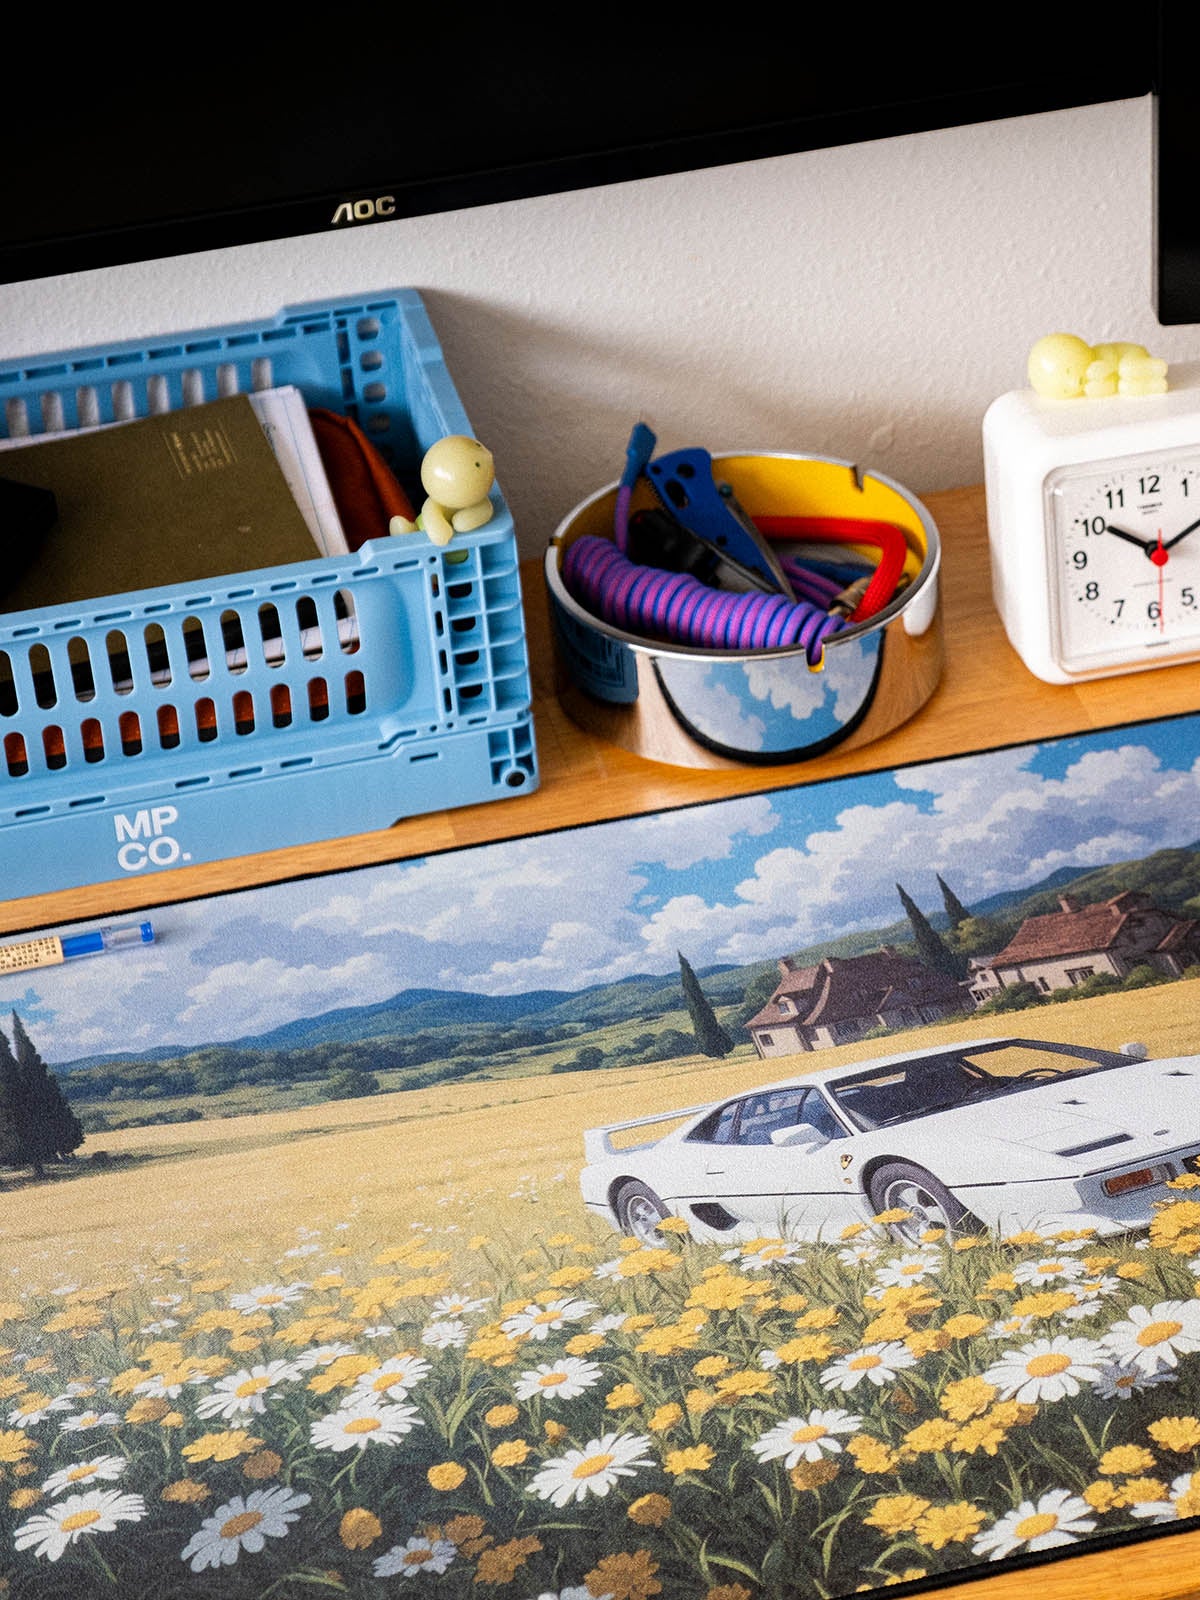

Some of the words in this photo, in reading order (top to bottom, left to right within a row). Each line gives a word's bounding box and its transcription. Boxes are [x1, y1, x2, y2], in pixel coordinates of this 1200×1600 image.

[331, 195, 396, 224] AOC
[1138, 475, 1160, 495] 12
[1181, 478, 1189, 497] 1
[1106, 488, 1125, 510] 11
[1082, 516, 1106, 537] 10
[1073, 551, 1088, 570] 9
[1085, 582, 1099, 601] 8
[1181, 588, 1194, 606] 5
[1113, 599, 1126, 618] 7
[1147, 602, 1161, 620] 6
[113, 805, 179, 842] MP
[117, 836, 192, 872] CO.
